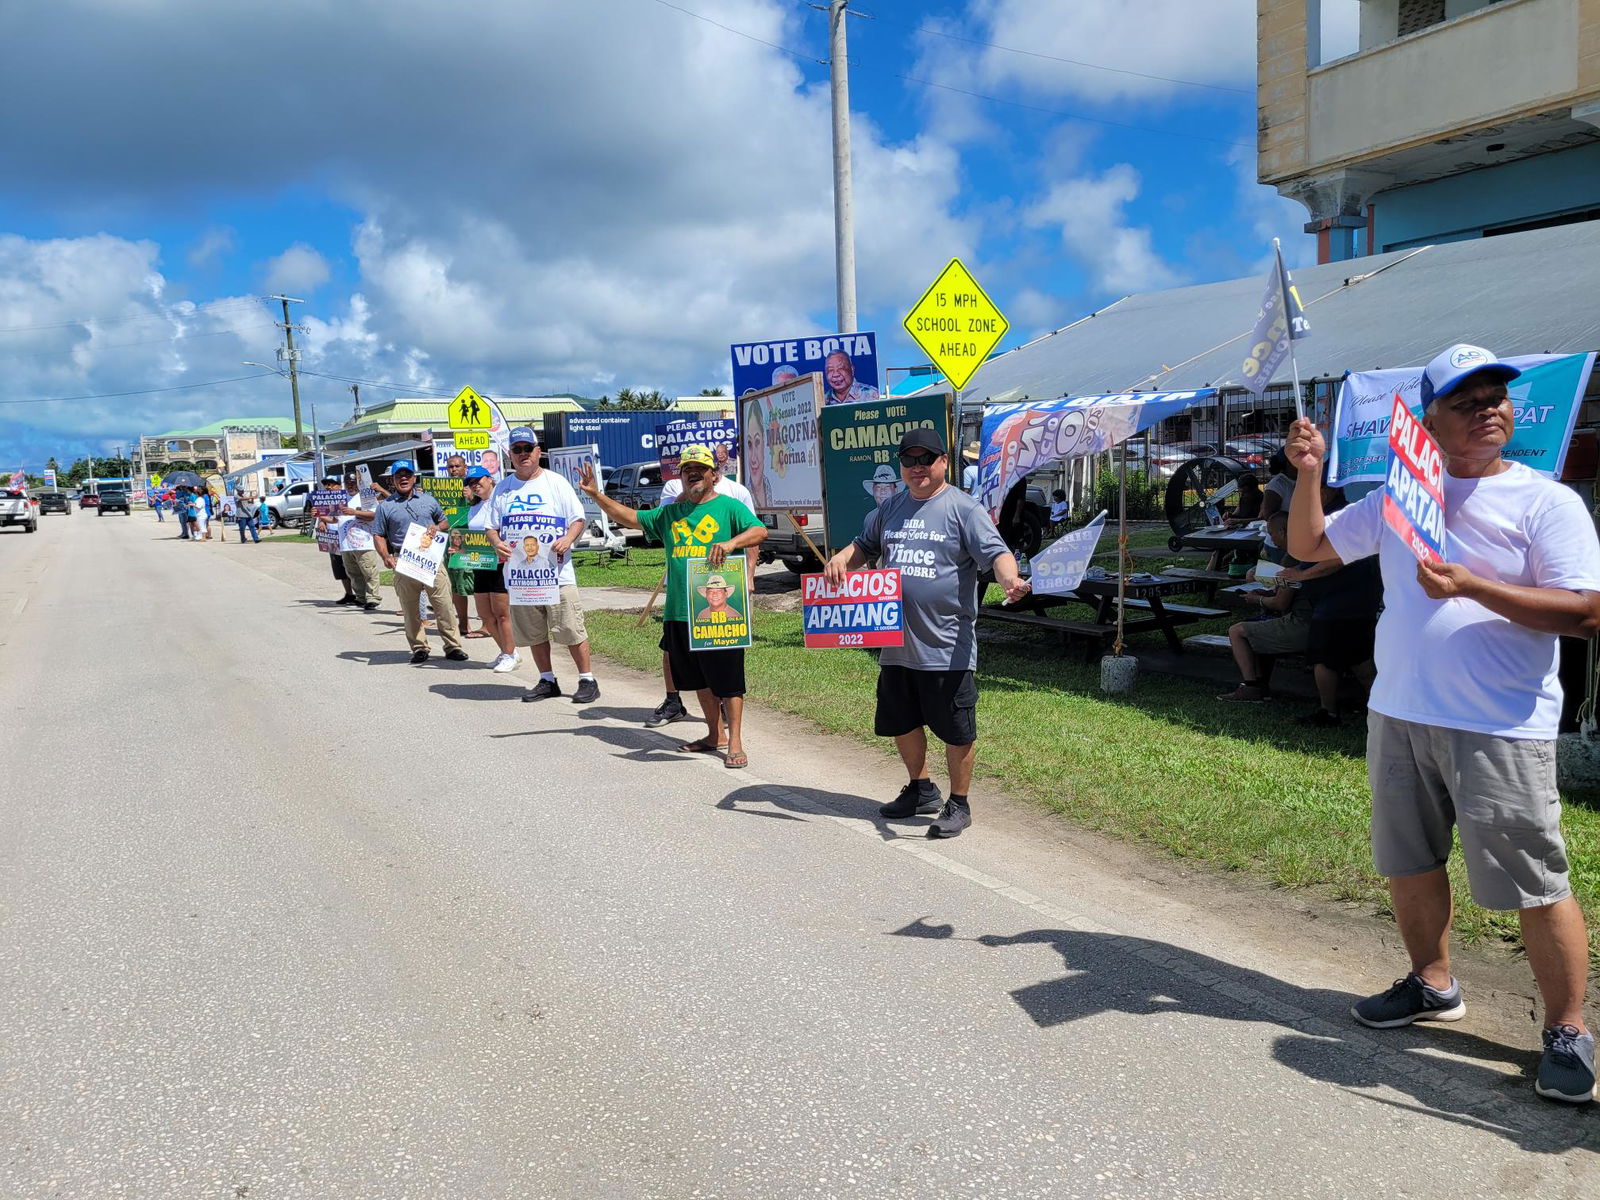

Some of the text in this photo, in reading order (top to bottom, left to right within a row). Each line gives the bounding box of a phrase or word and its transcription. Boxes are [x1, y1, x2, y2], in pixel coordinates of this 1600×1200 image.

[936, 293, 977, 308] 15 MPH
[916, 317, 996, 332] SCHOOL ZONE
[734, 335, 872, 366] VOTE BOTA
[939, 343, 976, 356] AHEAD
[781, 391, 795, 403] VOTE
[797, 401, 812, 416] 2022
[854, 405, 907, 421] Please VOTE!
[666, 420, 725, 432] PLEASE VOTE
[458, 435, 486, 446] AHEAD
[657, 428, 736, 445] PALACIOS
[779, 448, 806, 465] Corina
[873, 450, 890, 463] RB
[1500, 450, 1547, 458] PENDENT
[422, 478, 464, 491] RB CAMACHO
[434, 490, 463, 498] MAYOR
[508, 515, 556, 525] PLEASE VOTE
[884, 531, 908, 540] Please
[929, 531, 947, 542] for
[470, 552, 480, 561] RB
[672, 545, 707, 558] MAYOR
[887, 543, 936, 566] Vince
[403, 548, 438, 570] PALACIOS
[511, 568, 556, 579] PALACIOS
[900, 566, 937, 579] KOBRE
[512, 579, 539, 587] RAYMOND
[805, 571, 898, 600] PALACIOS
[711, 611, 727, 624] RB
[807, 602, 899, 629] APATANG
[692, 622, 748, 640] CAMACHO
[713, 637, 739, 647] Mayor
[838, 633, 864, 645] 2022
